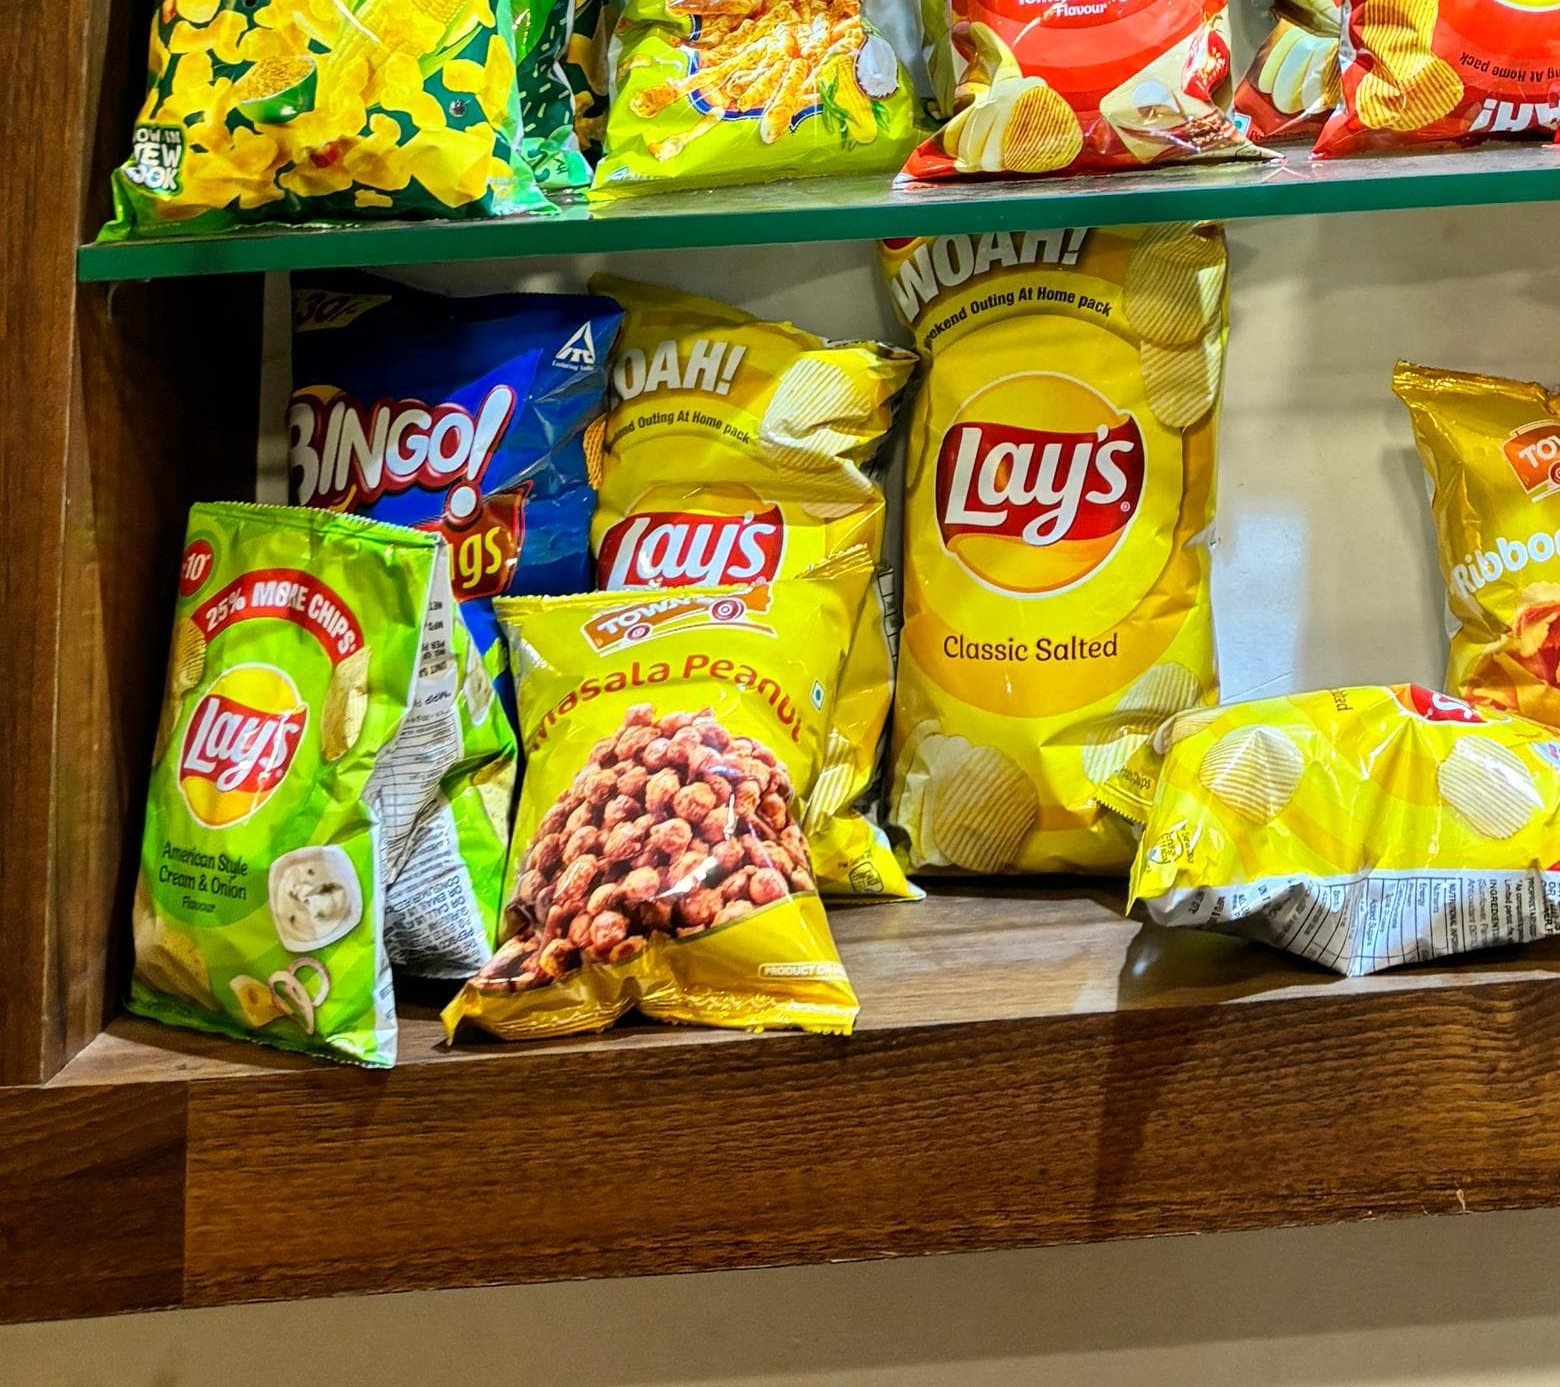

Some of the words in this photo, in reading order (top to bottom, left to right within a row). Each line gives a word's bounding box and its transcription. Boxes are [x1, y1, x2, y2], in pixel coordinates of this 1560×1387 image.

[1055, 2, 1108, 17] Flavour
[1458, 50, 1491, 74] pack
[1491, 66, 1527, 84] Home
[1529, 70, 1544, 84] At
[970, 288, 1016, 316] Outing
[1017, 286, 1034, 302] At
[1036, 286, 1076, 304] Home
[1077, 295, 1113, 318] pack
[638, 411, 676, 429] Outing
[677, 408, 690, 422] At
[691, 409, 723, 431] Home
[724, 421, 752, 446] pack
[289, 384, 515, 520] BINGO!
[943, 423, 1136, 547] Lay's
[606, 510, 777, 591] Lay's
[205, 587, 246, 632] 25%
[251, 580, 306, 613] MORE
[943, 634, 1029, 663] Classic
[1033, 632, 1119, 663] Salted
[183, 697, 301, 793] Lay's
[162, 840, 216, 870] American
[217, 853, 249, 883] Style
[159, 864, 196, 891] Cream
[198, 873, 208, 893] &
[211, 876, 247, 901] Onion
[182, 895, 216, 914] Flavour
